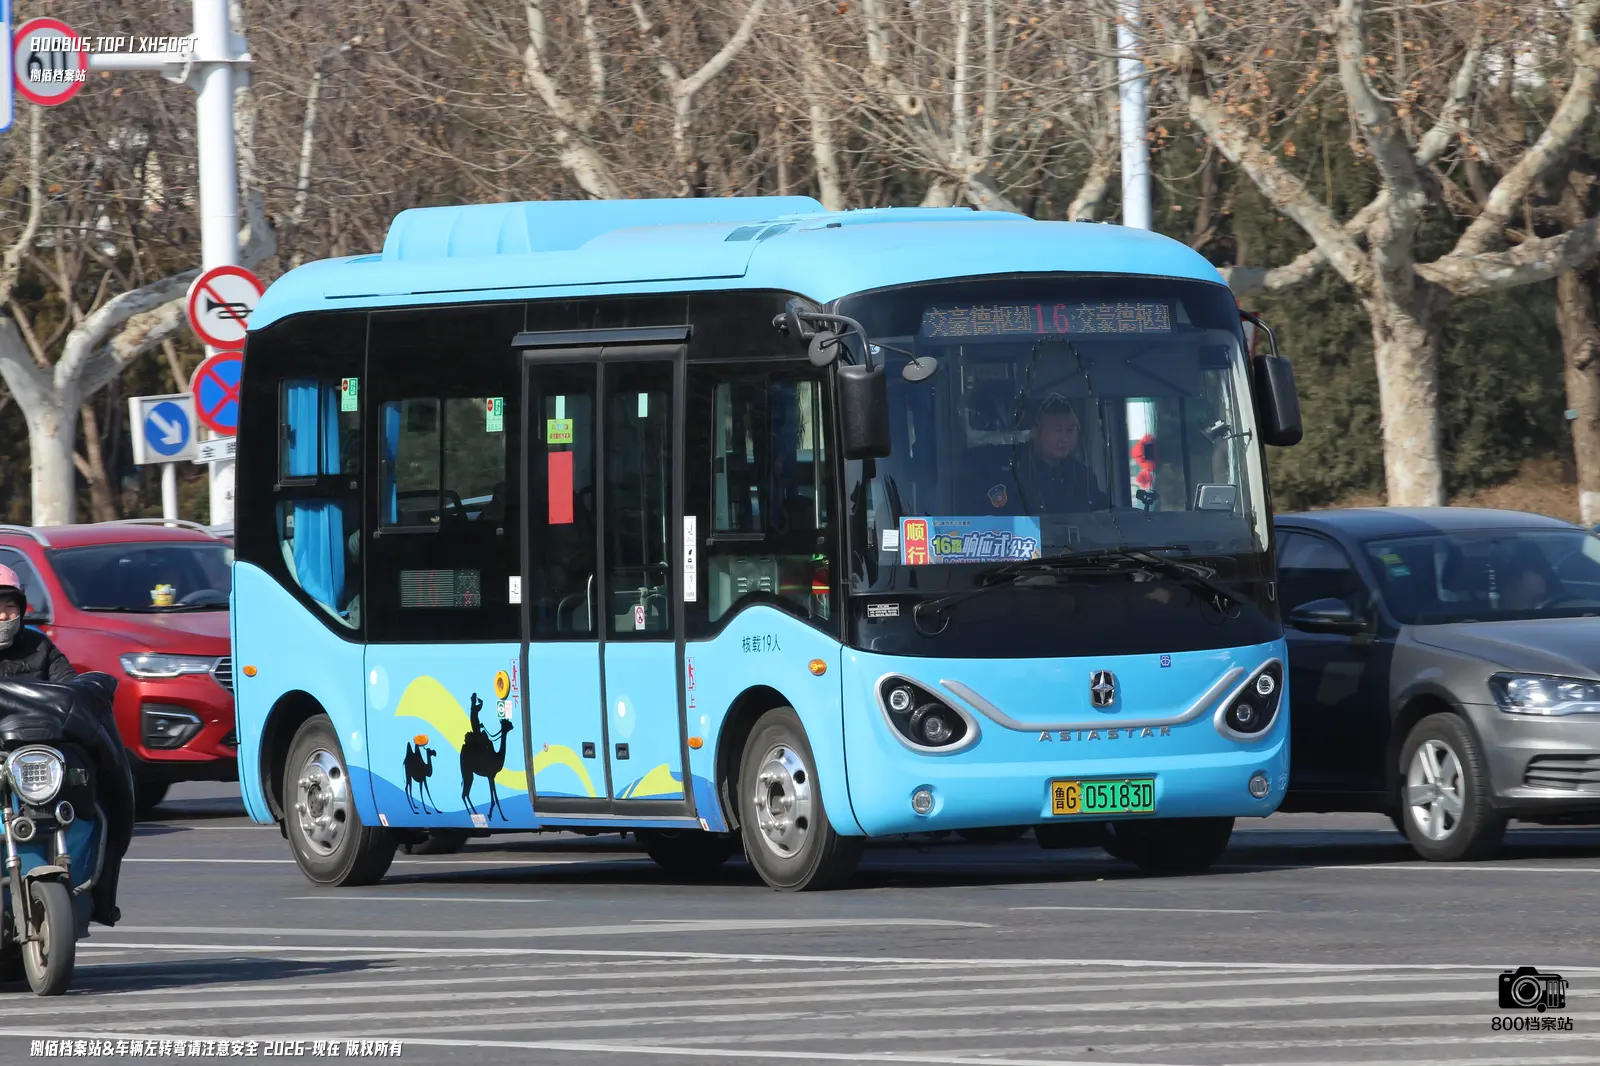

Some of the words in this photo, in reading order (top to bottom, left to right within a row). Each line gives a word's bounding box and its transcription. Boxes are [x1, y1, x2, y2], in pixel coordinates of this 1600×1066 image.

[1032, 303, 1070, 334] 16
[906, 523, 926, 566] 顺行
[933, 533, 1035, 559] 16路响应式公交
[742, 634, 781, 653] 核载19人
[1038, 726, 1171, 742] ASIASTAR
[1054, 786, 1077, 810] 鲁G
[1086, 784, 1152, 809] 05183D
